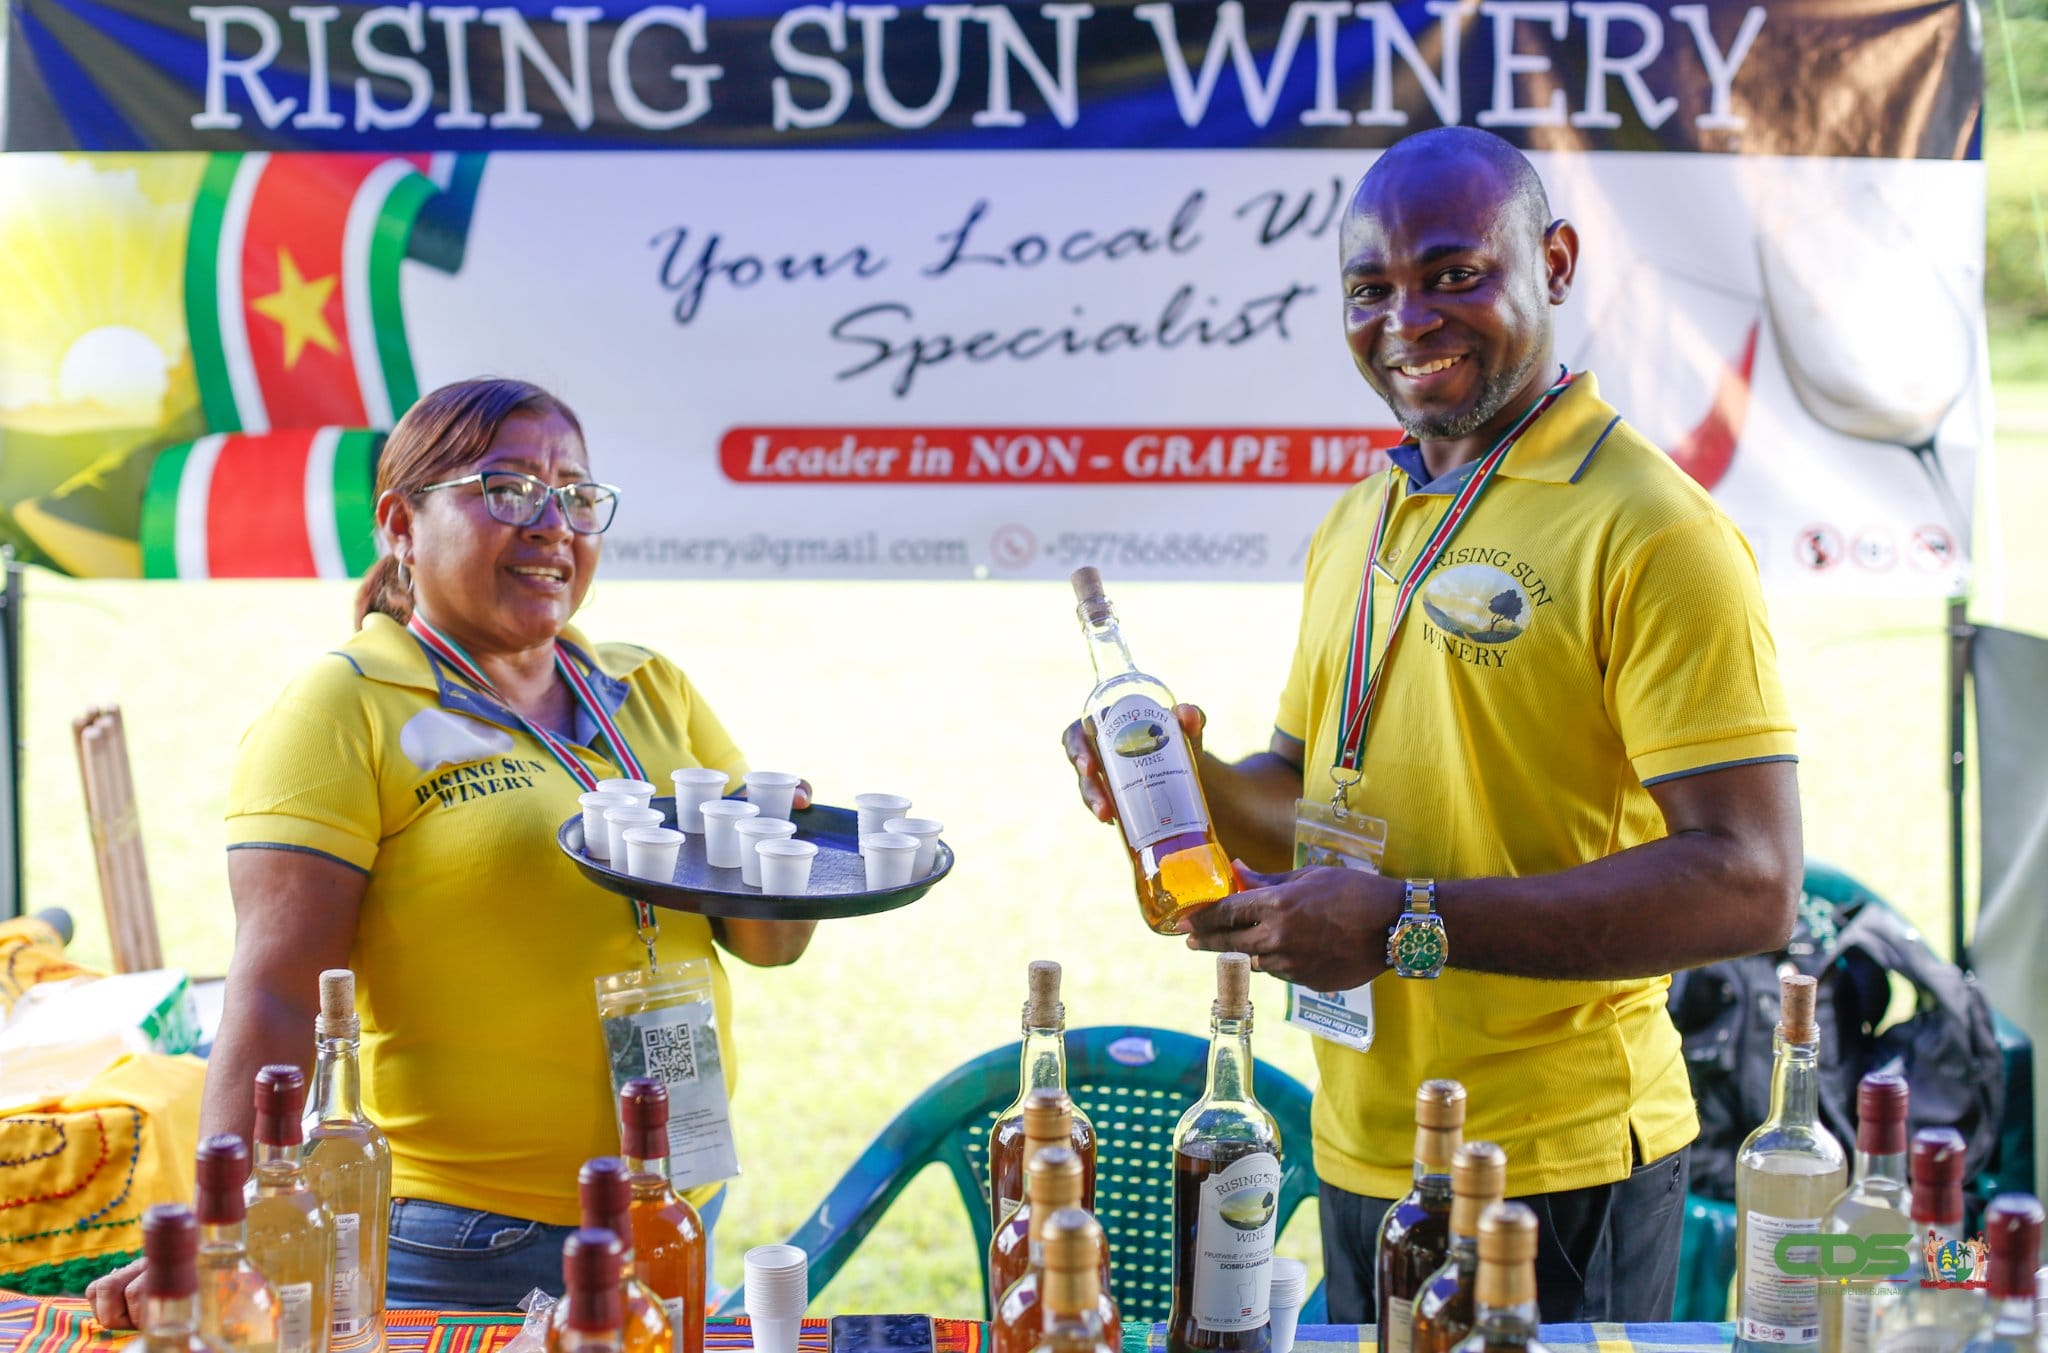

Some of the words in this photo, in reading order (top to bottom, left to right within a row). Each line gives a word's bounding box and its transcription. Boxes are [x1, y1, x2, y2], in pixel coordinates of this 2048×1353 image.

[190, 2, 724, 132] RISING
[771, 1, 1094, 131] SUN
[1133, 1, 1766, 130] WINERY
[649, 225, 888, 325] Your
[922, 190, 1208, 277] Local
[830, 282, 1318, 399] Specialist
[747, 434, 900, 477] Leader
[908, 434, 954, 477] in
[966, 434, 1084, 477] NON
[1121, 434, 1292, 477] GRAPE
[1433, 548, 1512, 571] RISING
[1511, 562, 1553, 607] SUN
[1423, 623, 1508, 667] WINERY
[1105, 709, 1141, 738] RISING
[1144, 708, 1169, 723] SUN
[1133, 753, 1165, 769] WINE
[415, 761, 496, 805] RISING
[436, 775, 535, 808] WINERY
[1303, 1010, 1332, 1026] CARICOM
[1346, 1025, 1364, 1037] EXPO
[1215, 1173, 1263, 1196] RISING
[1236, 1229, 1266, 1243] WINE
